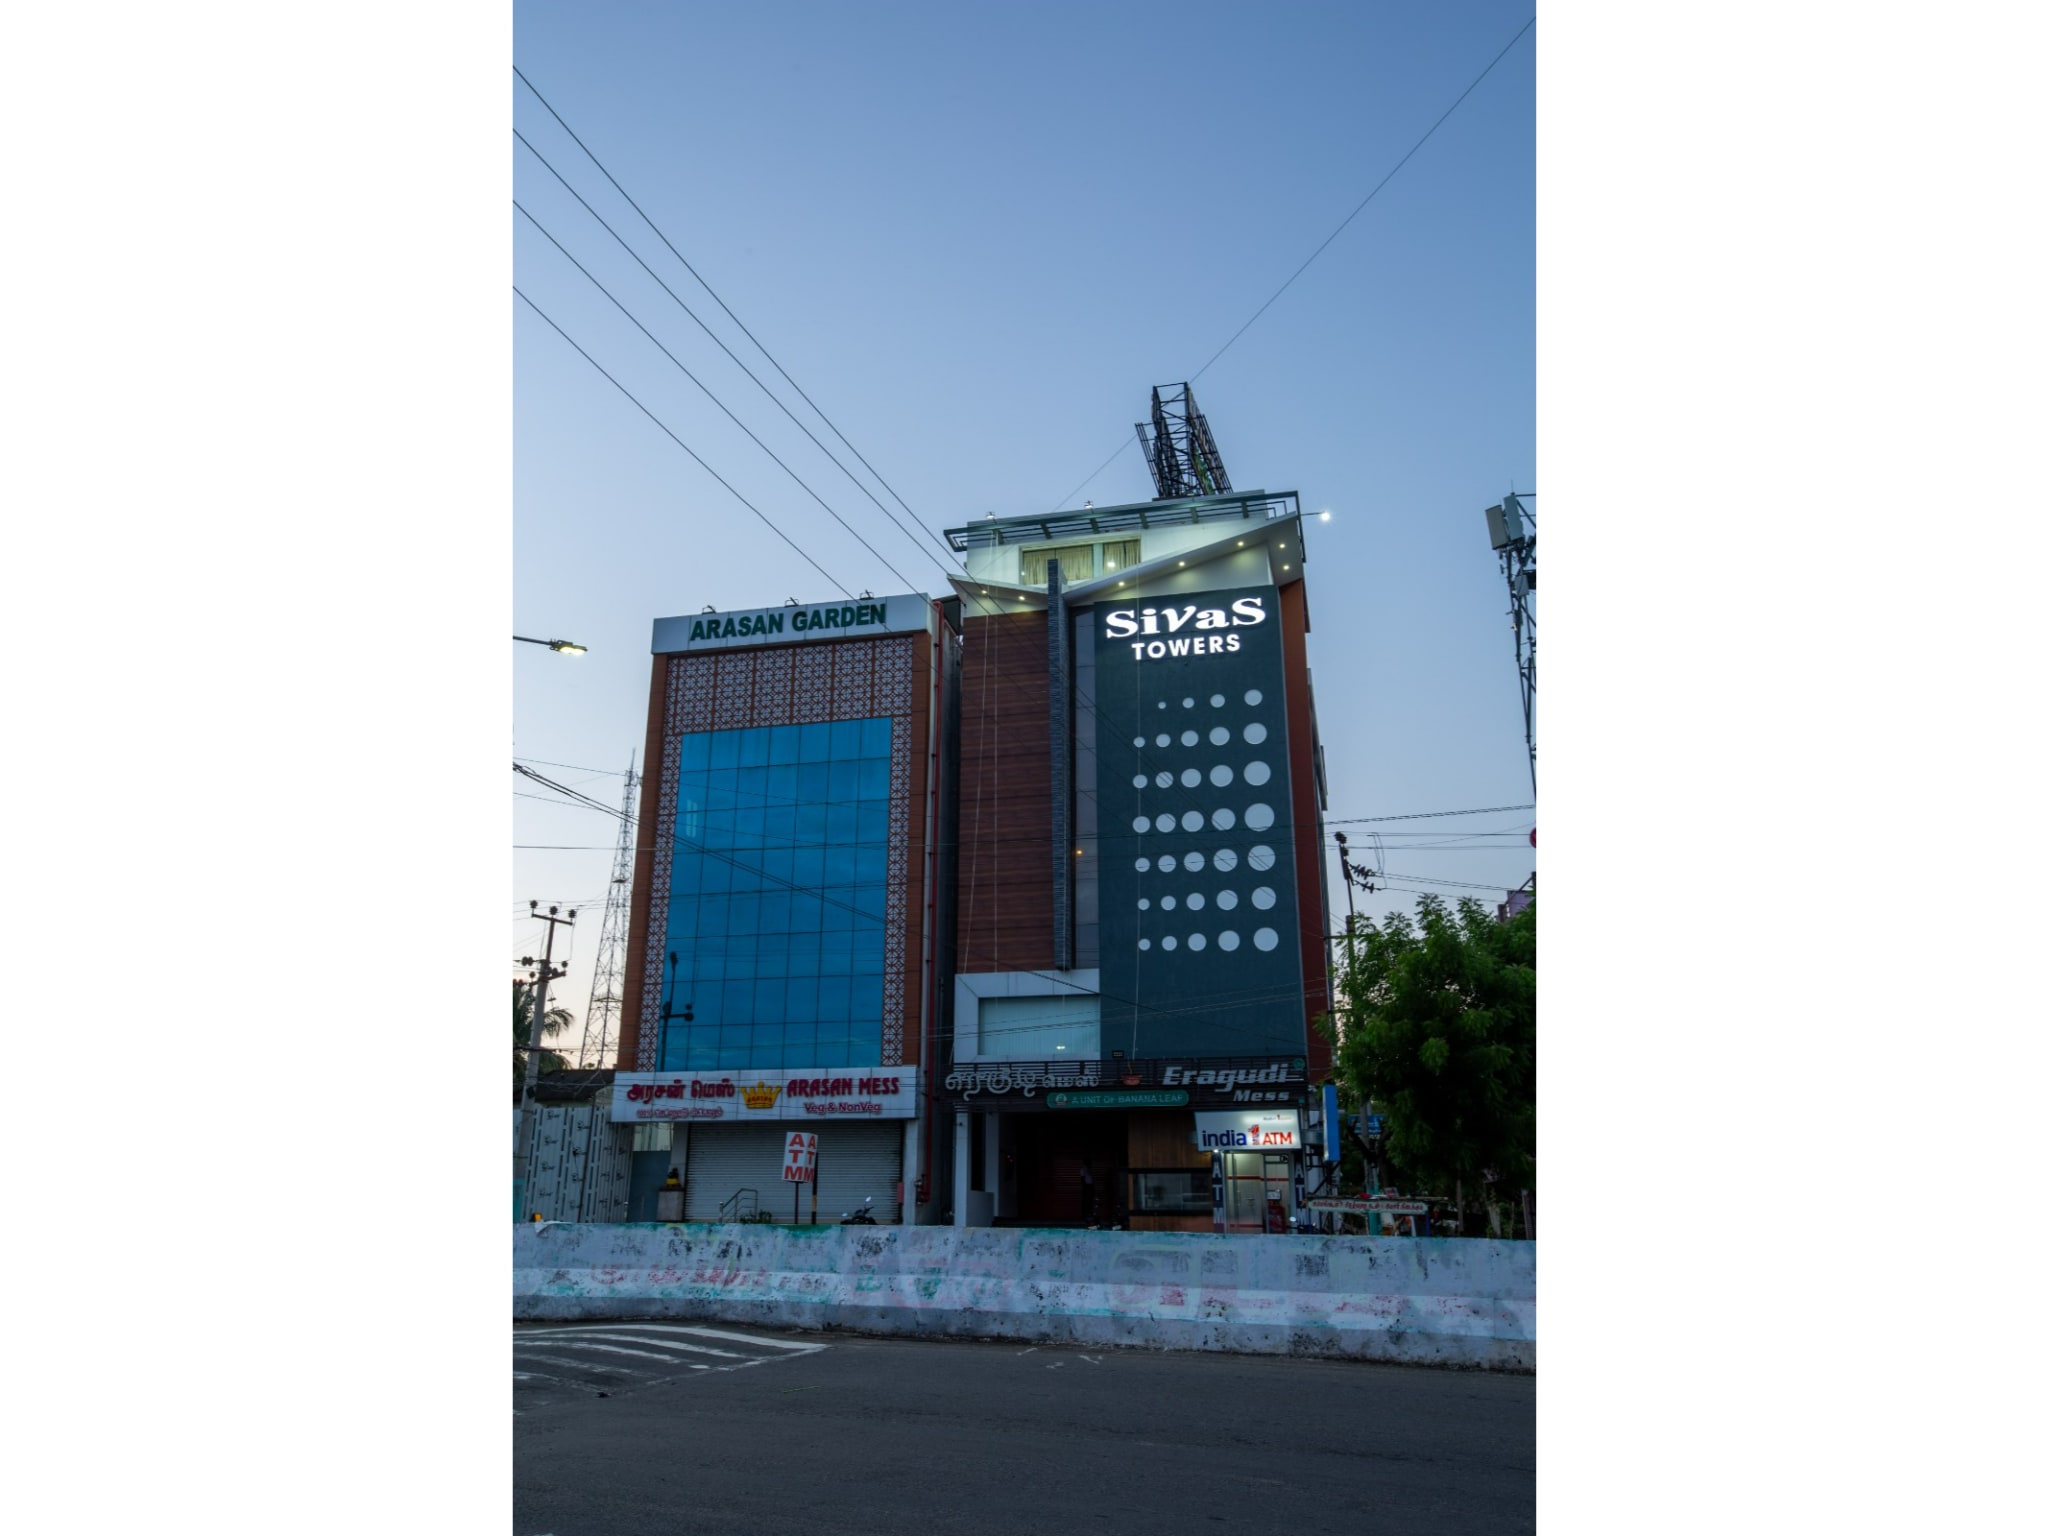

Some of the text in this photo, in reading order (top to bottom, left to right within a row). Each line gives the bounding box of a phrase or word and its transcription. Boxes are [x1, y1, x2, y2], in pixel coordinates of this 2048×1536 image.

[690, 604, 886, 641] ARASAN GARDEN
[1131, 634, 1241, 660] TOWERS
[628, 1079, 685, 1104] அரசன்
[787, 1077, 899, 1097] ARASAN MESS
[1164, 1065, 1287, 1093] Eragudi
[1080, 1095, 1102, 1104] UNIT
[1234, 1089, 1289, 1102] Mess
[804, 1102, 826, 1115] Veg
[827, 1102, 837, 1112] &
[1263, 1132, 1292, 1145] ATM
[785, 1135, 804, 1180] ATM
[805, 1136, 816, 1181] ATM
